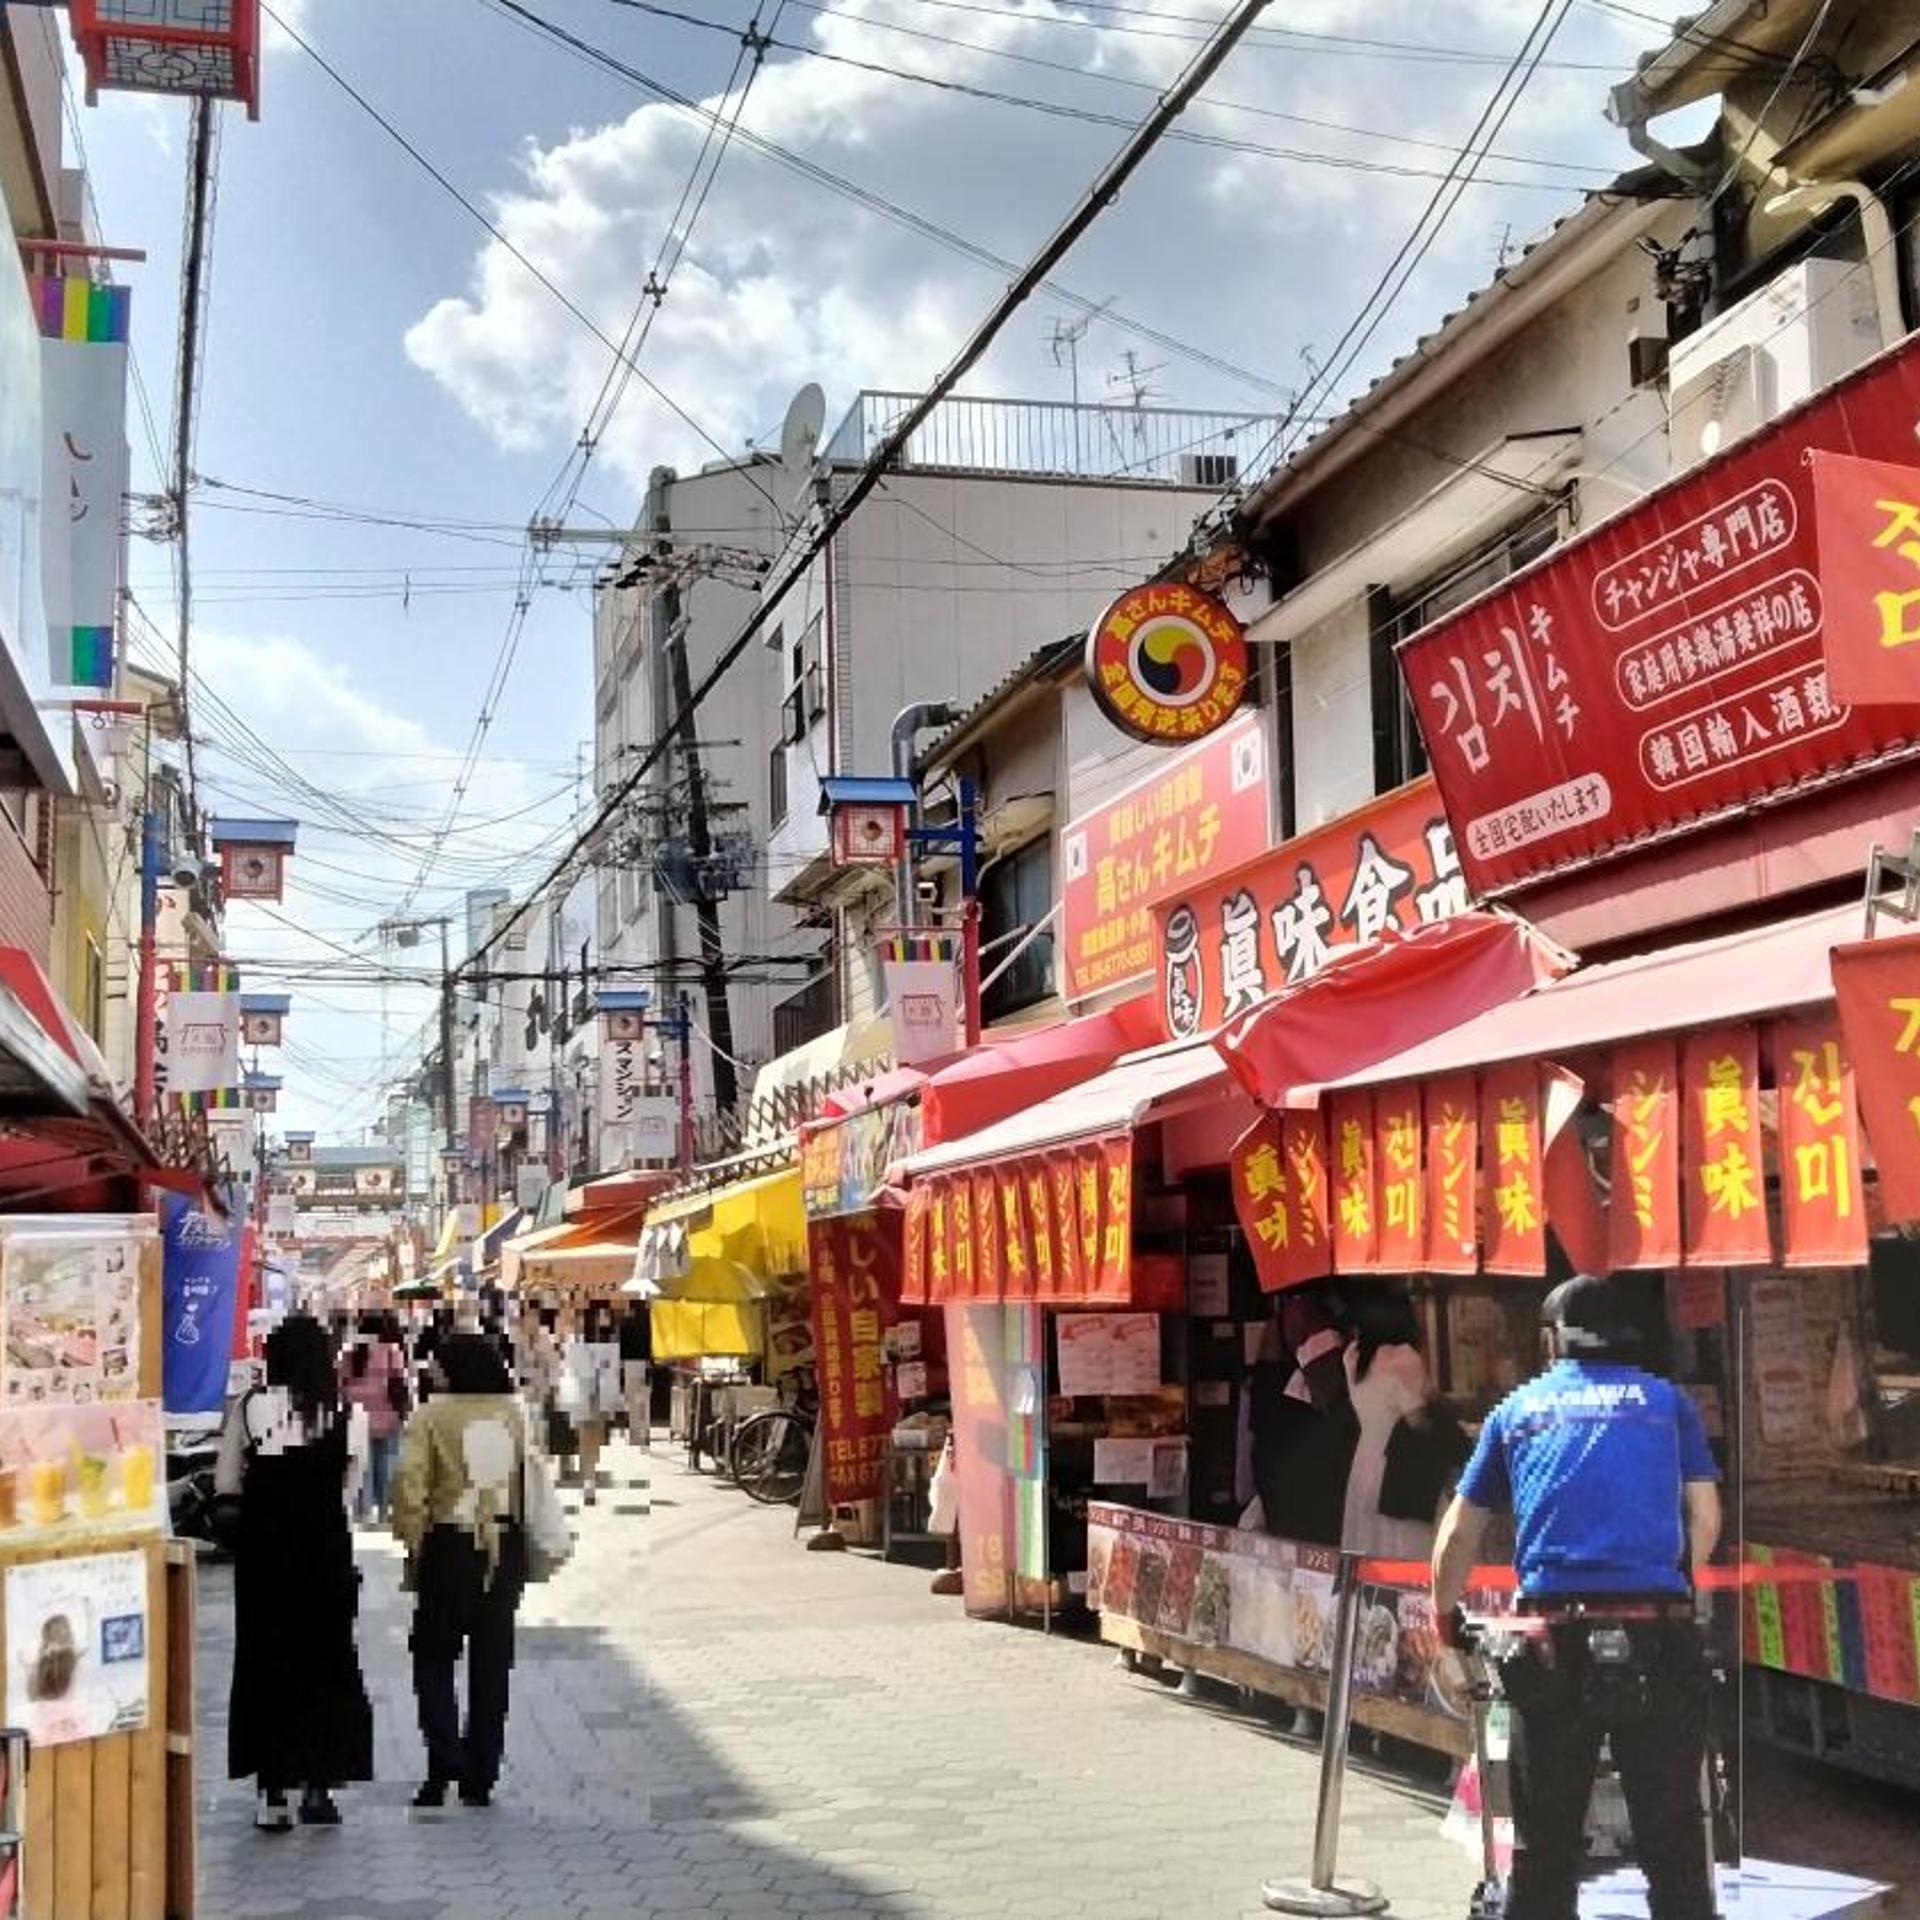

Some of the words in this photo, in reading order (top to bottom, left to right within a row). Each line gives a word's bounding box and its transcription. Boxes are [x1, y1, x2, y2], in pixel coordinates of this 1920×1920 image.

[1605, 491, 1786, 620] チャンジャ専門店
[1431, 627, 1544, 774] 김치
[1529, 603, 1580, 740] キムチ
[1649, 674, 1840, 780] 韓国輸入酒類
[1475, 780, 1600, 855] 全国宅配いたします
[1792, 1041, 1850, 1219] 진미
